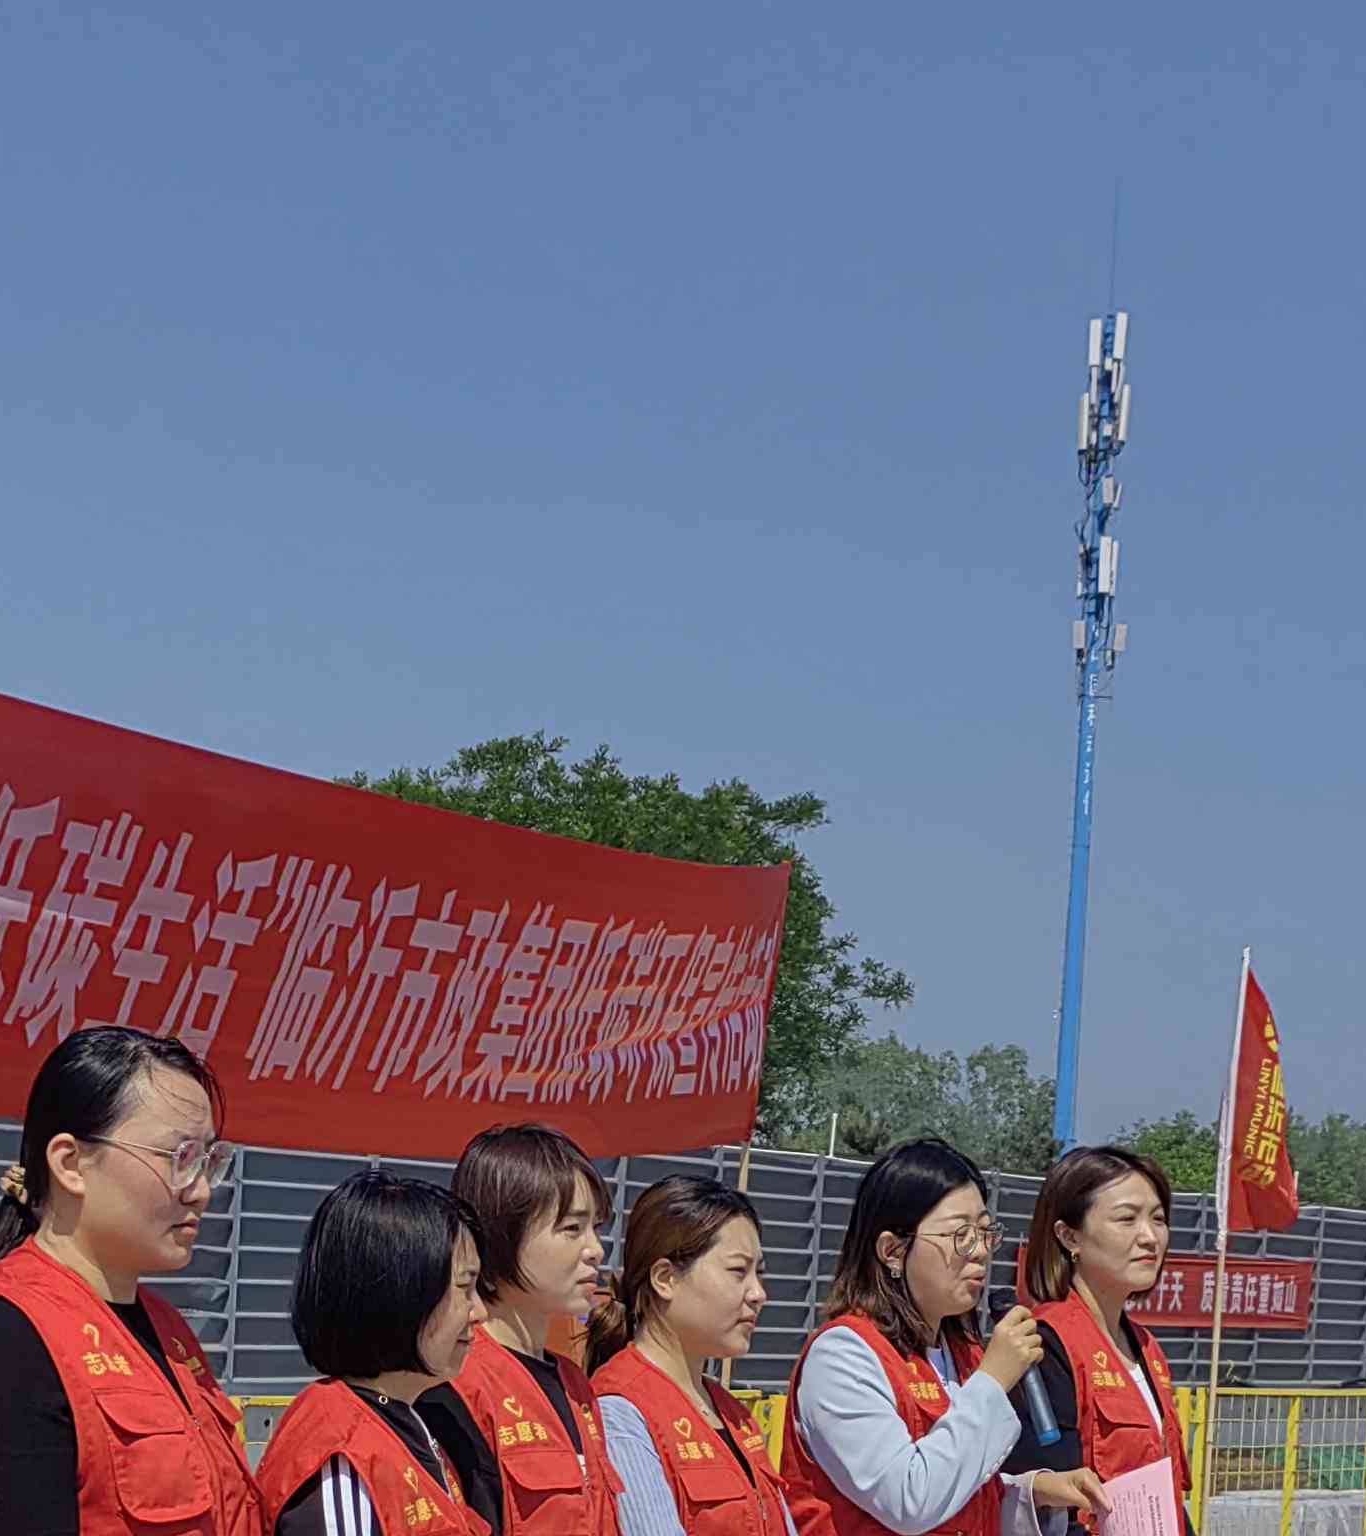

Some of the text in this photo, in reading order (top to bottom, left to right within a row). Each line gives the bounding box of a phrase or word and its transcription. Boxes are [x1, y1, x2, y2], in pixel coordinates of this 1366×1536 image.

[498, 1421, 548, 1446] 志愿者
[675, 1441, 715, 1460] 志愿者
